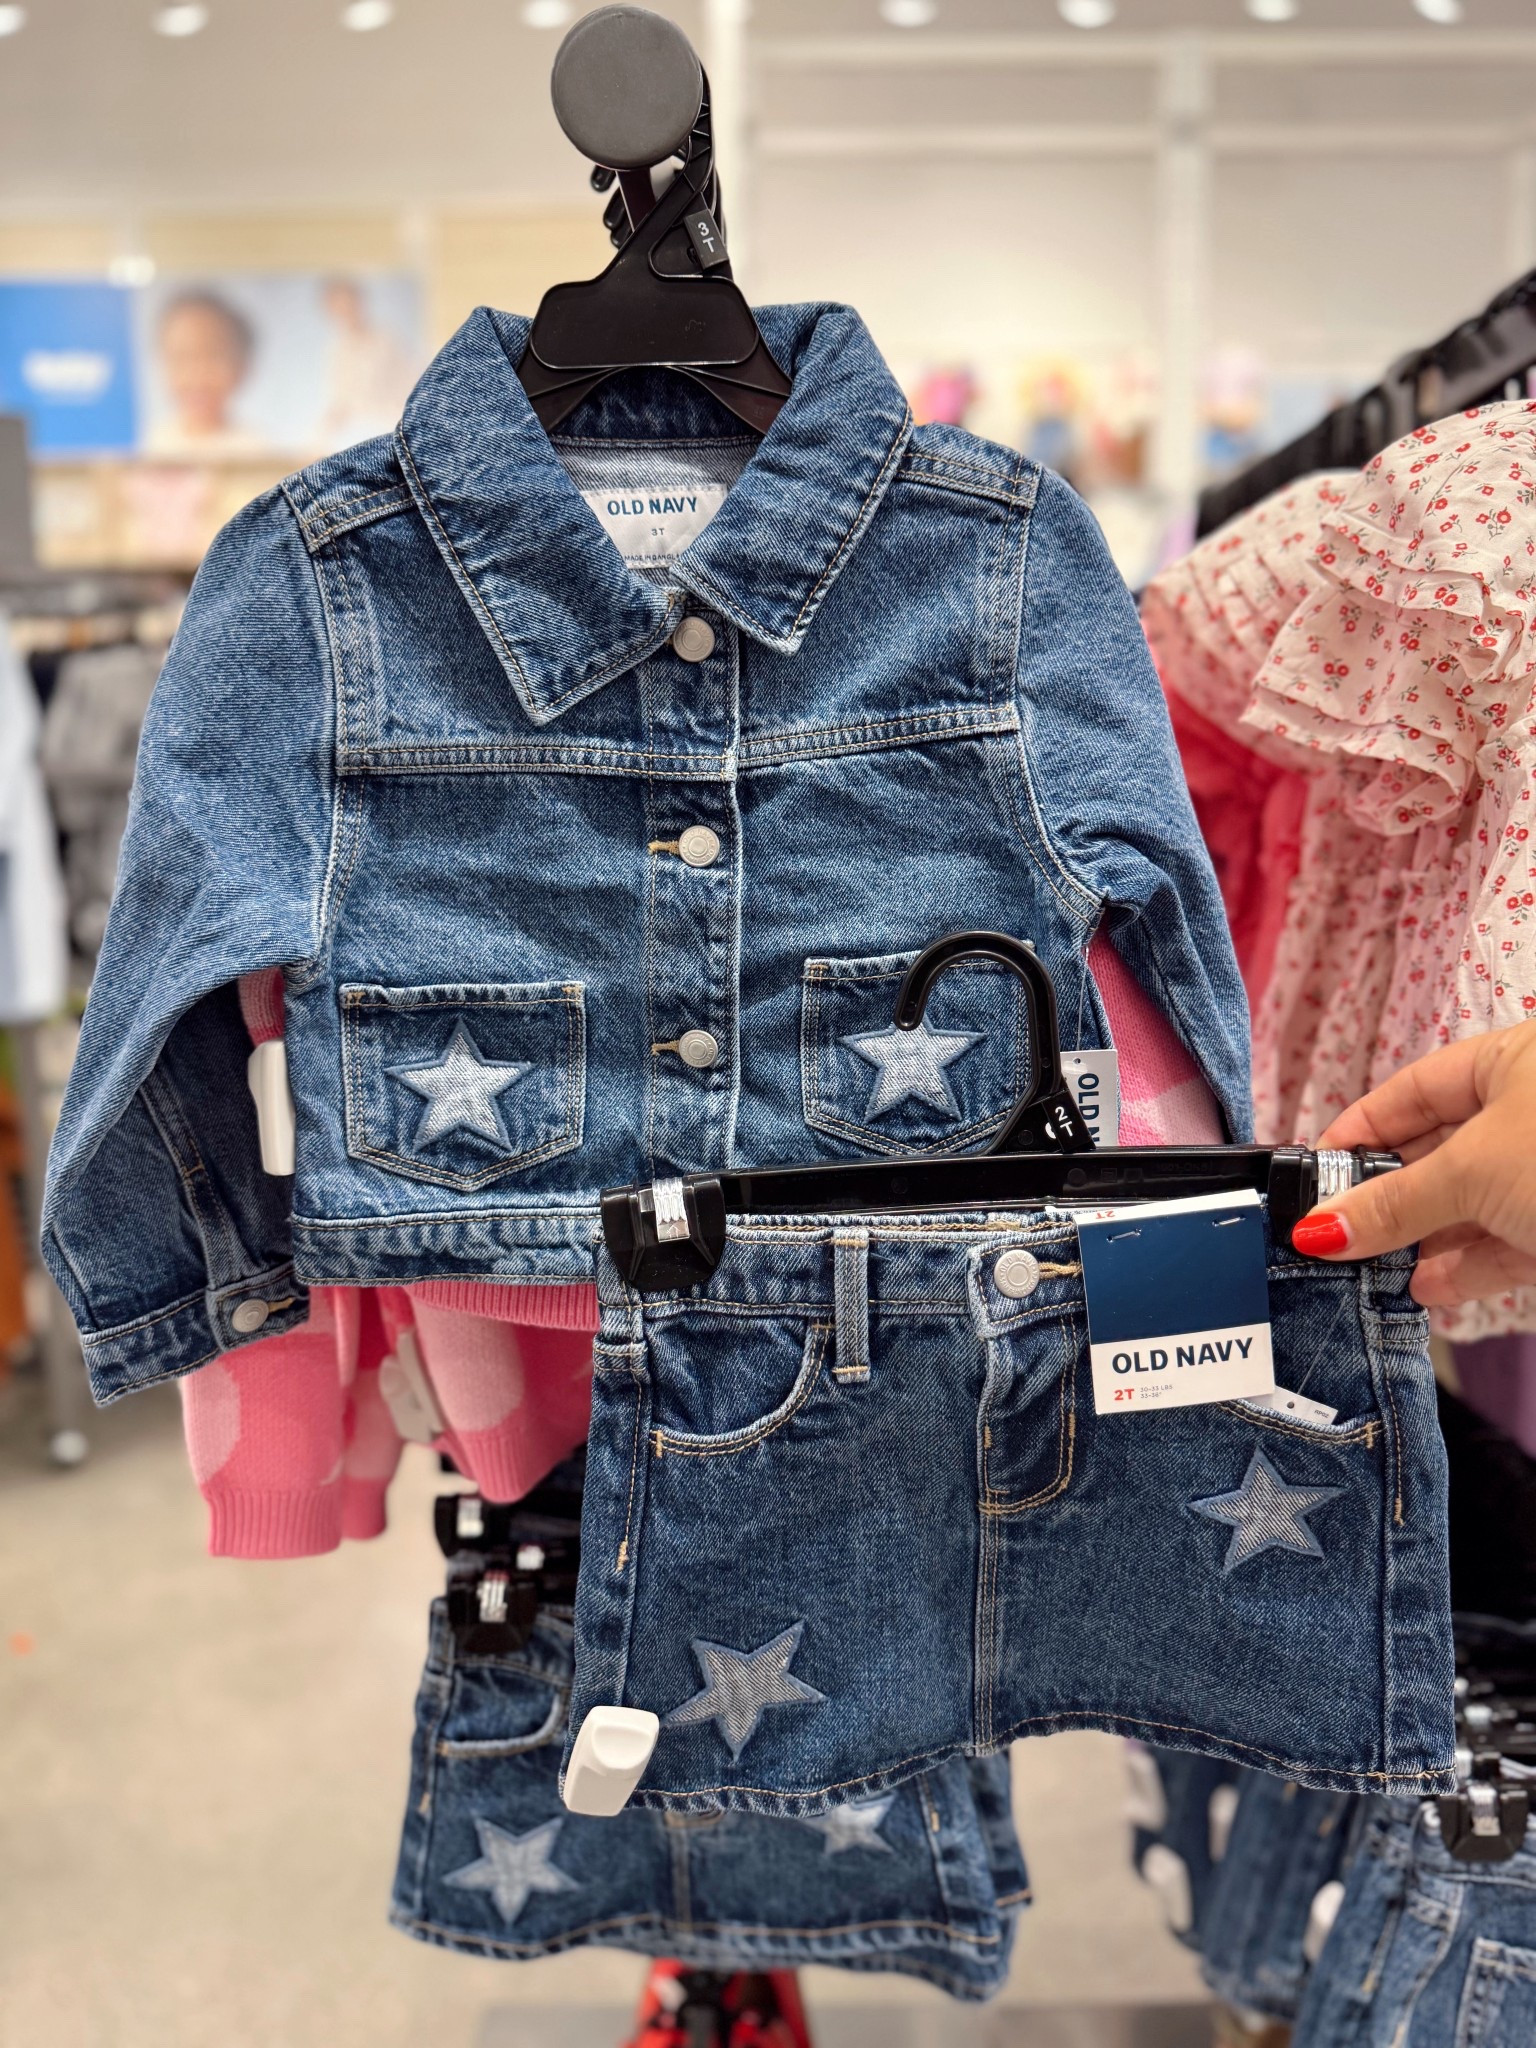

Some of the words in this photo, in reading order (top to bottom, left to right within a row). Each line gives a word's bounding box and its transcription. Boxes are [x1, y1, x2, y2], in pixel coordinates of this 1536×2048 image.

[607, 499, 644, 516] OLD
[649, 497, 698, 514] NAVY
[651, 528, 665, 536] 3T
[1077, 1073, 1100, 1121] OLD
[1055, 1106, 1073, 1137] 2T
[1111, 1349, 1168, 1375] OLD
[1176, 1337, 1253, 1368] NAVY
[1114, 1388, 1135, 1401] 2T
